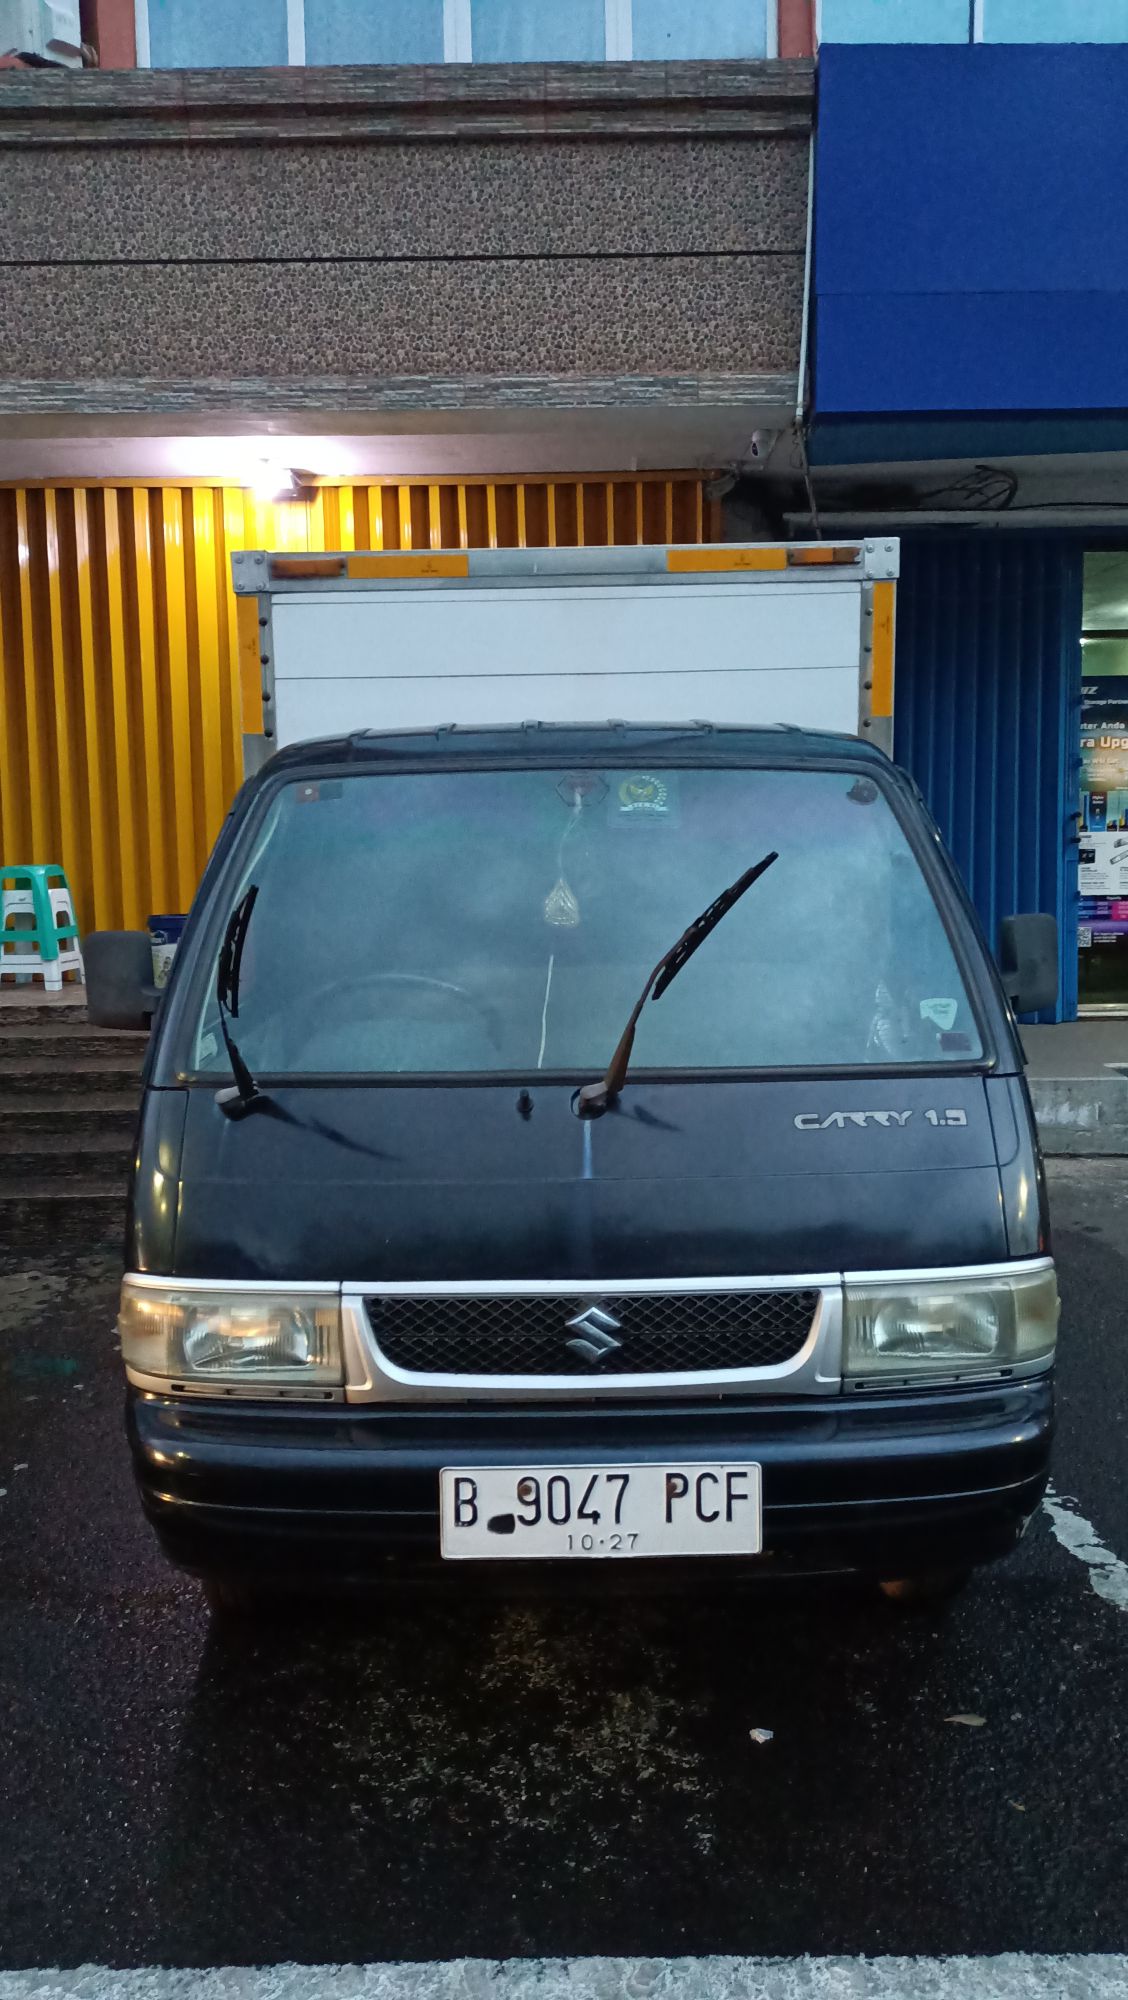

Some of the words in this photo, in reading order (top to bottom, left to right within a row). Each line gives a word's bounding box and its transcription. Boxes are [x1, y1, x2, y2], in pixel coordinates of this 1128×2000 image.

[794, 1110, 912, 1129] CARRY
[925, 1109, 968, 1126] 1.5
[454, 1477, 478, 1527] B
[517, 1474, 630, 1526] 9047
[666, 1472, 748, 1523] PCF
